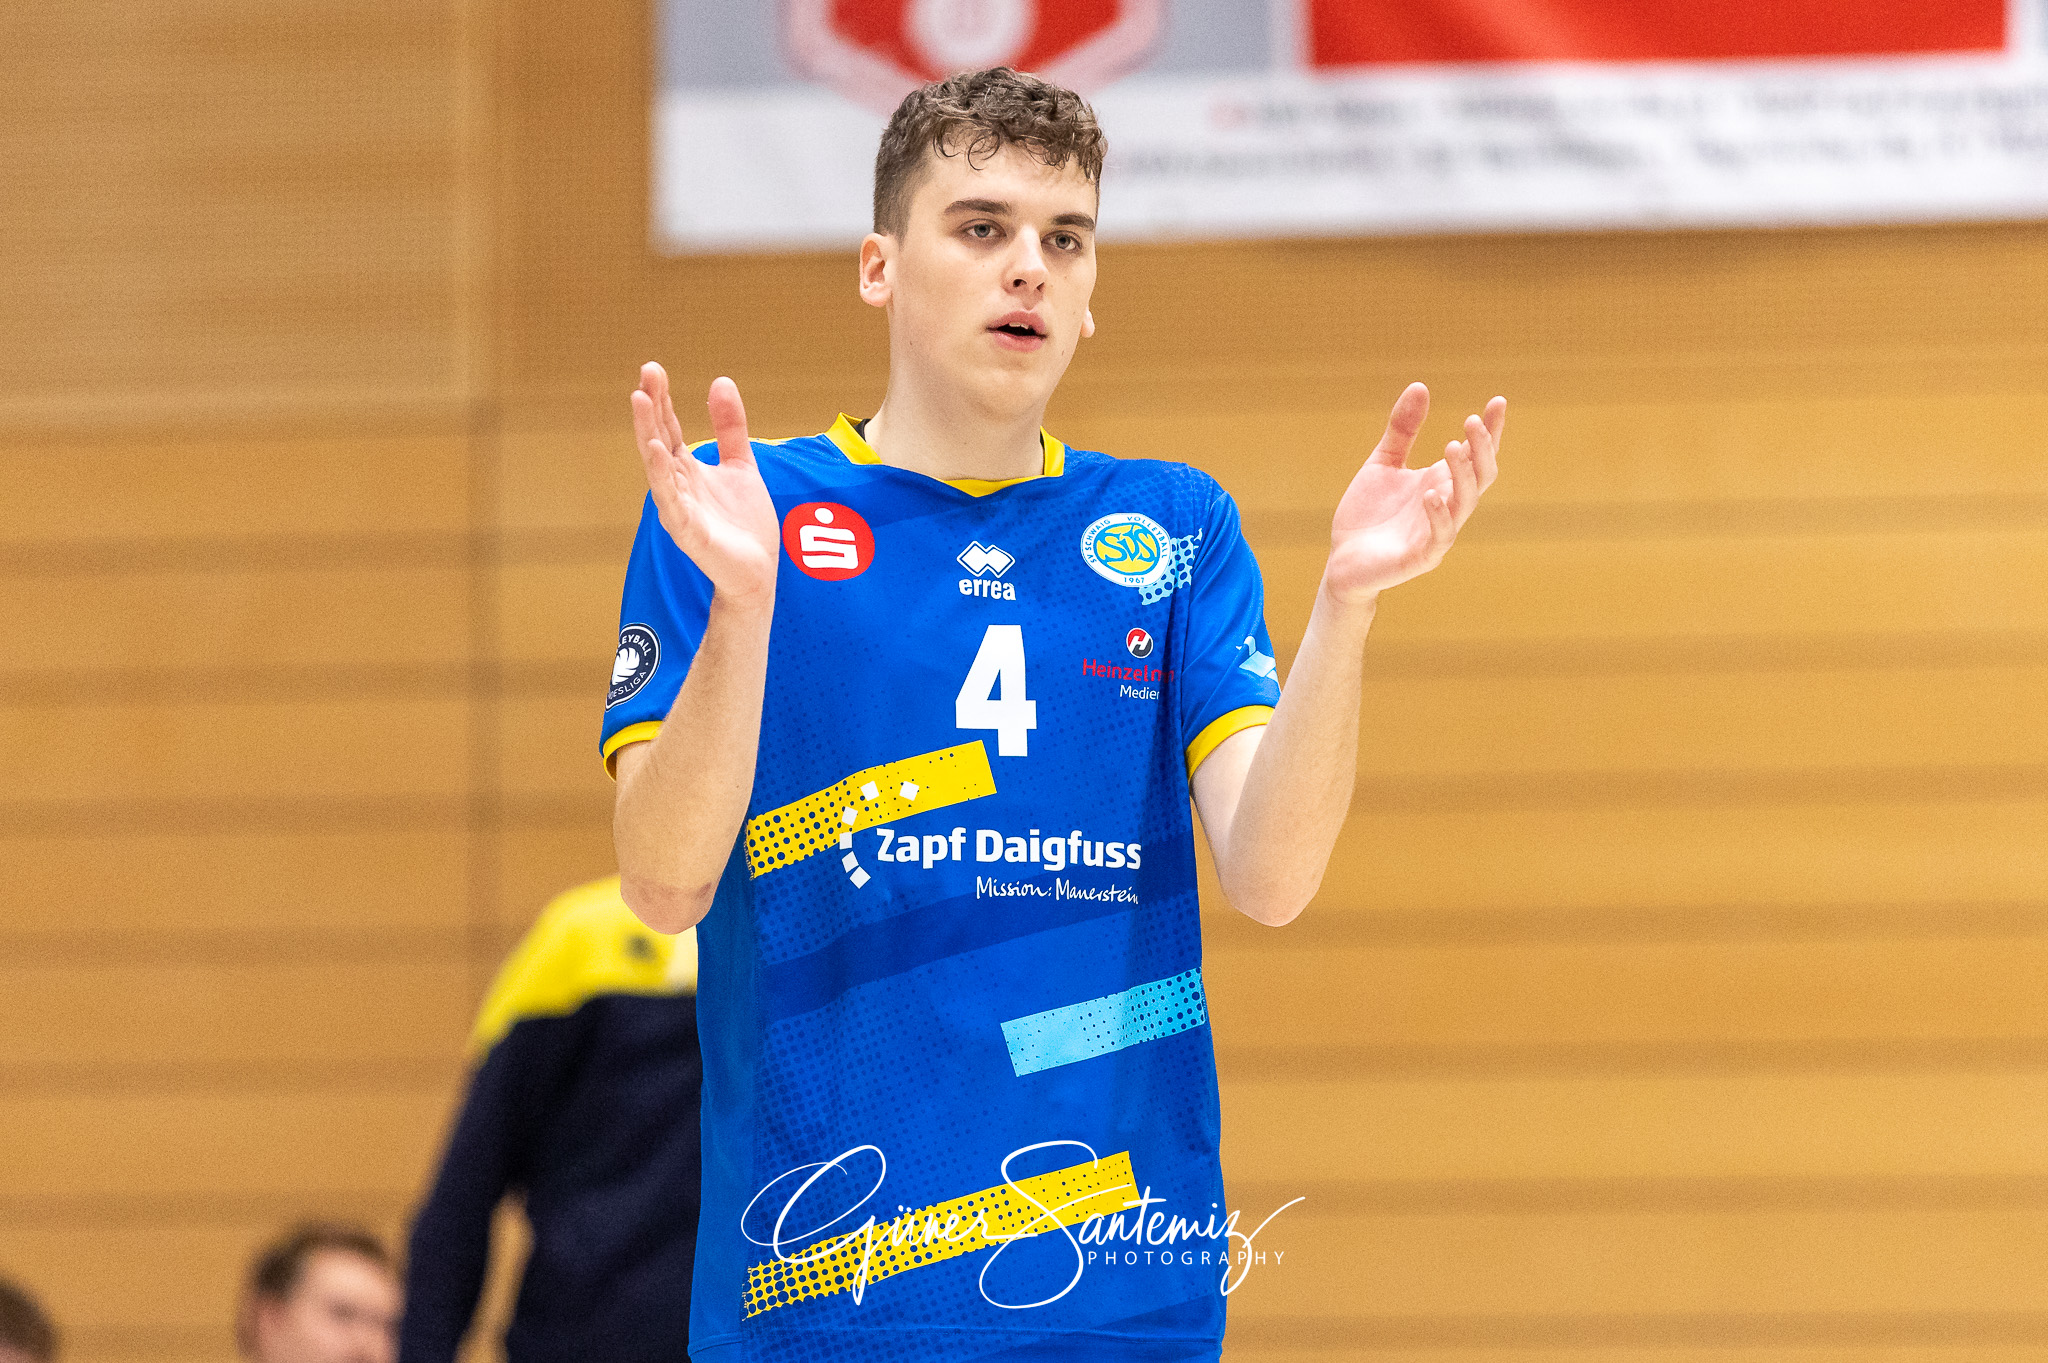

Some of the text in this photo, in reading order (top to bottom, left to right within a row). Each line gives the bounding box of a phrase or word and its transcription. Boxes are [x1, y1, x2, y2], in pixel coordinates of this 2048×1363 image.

[1084, 516, 1168, 564] SV SCHWAIG VOLLEYBALL
[1123, 576, 1145, 584] 1967
[619, 634, 652, 657] EYBALL
[955, 624, 1037, 757] 4
[876, 827, 1142, 871] Zapf Daigfuss
[976, 875, 1052, 900] Mission:
